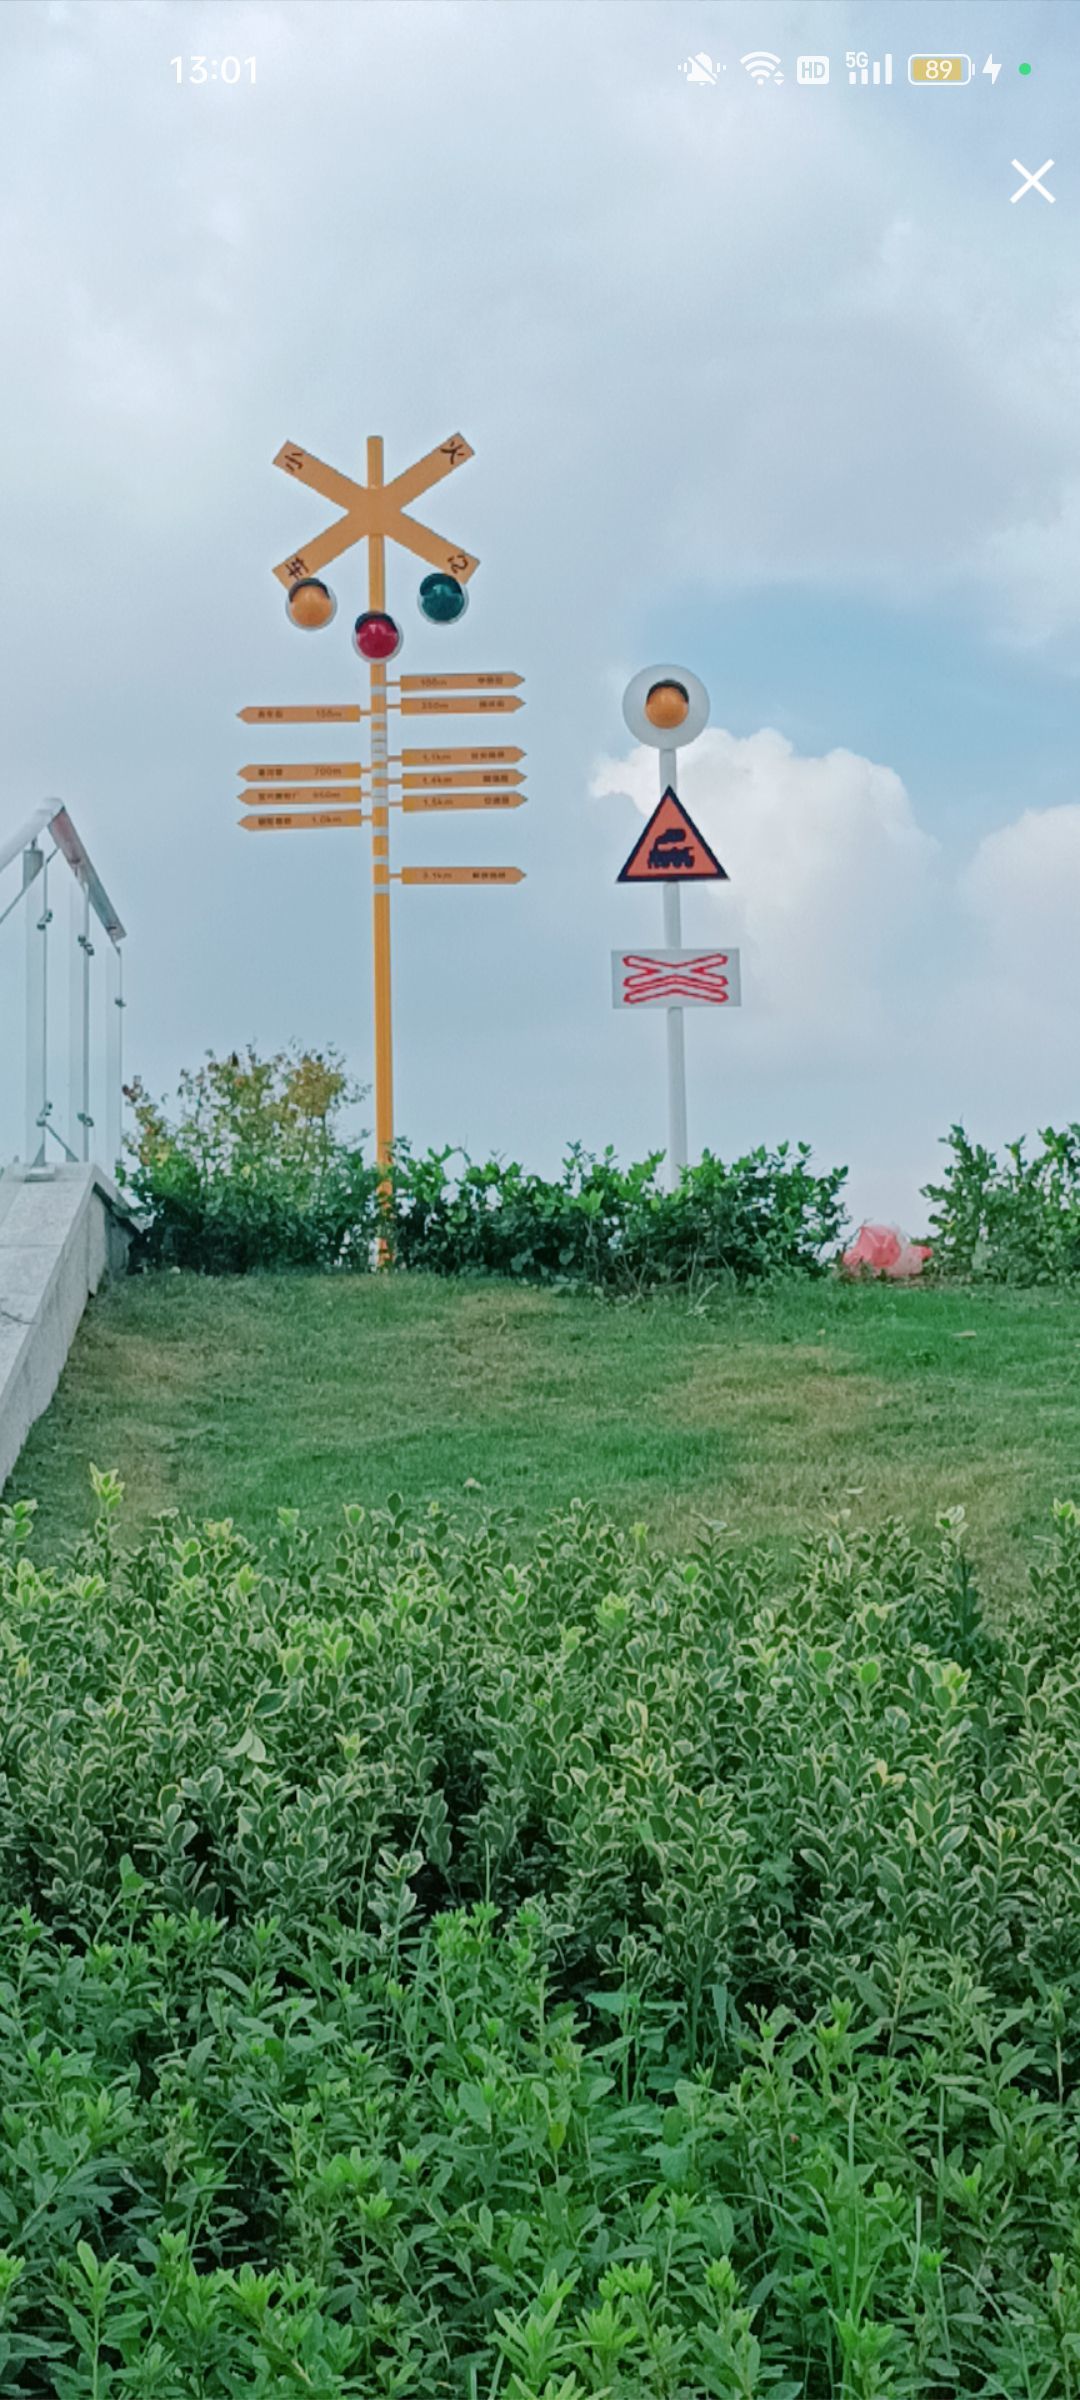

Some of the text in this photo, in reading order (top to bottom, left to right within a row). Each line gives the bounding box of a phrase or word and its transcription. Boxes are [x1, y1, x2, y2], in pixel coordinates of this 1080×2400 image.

[284, 450, 304, 473] 小
[439, 440, 465, 465] 火
[314, 766, 342, 777] 700m
